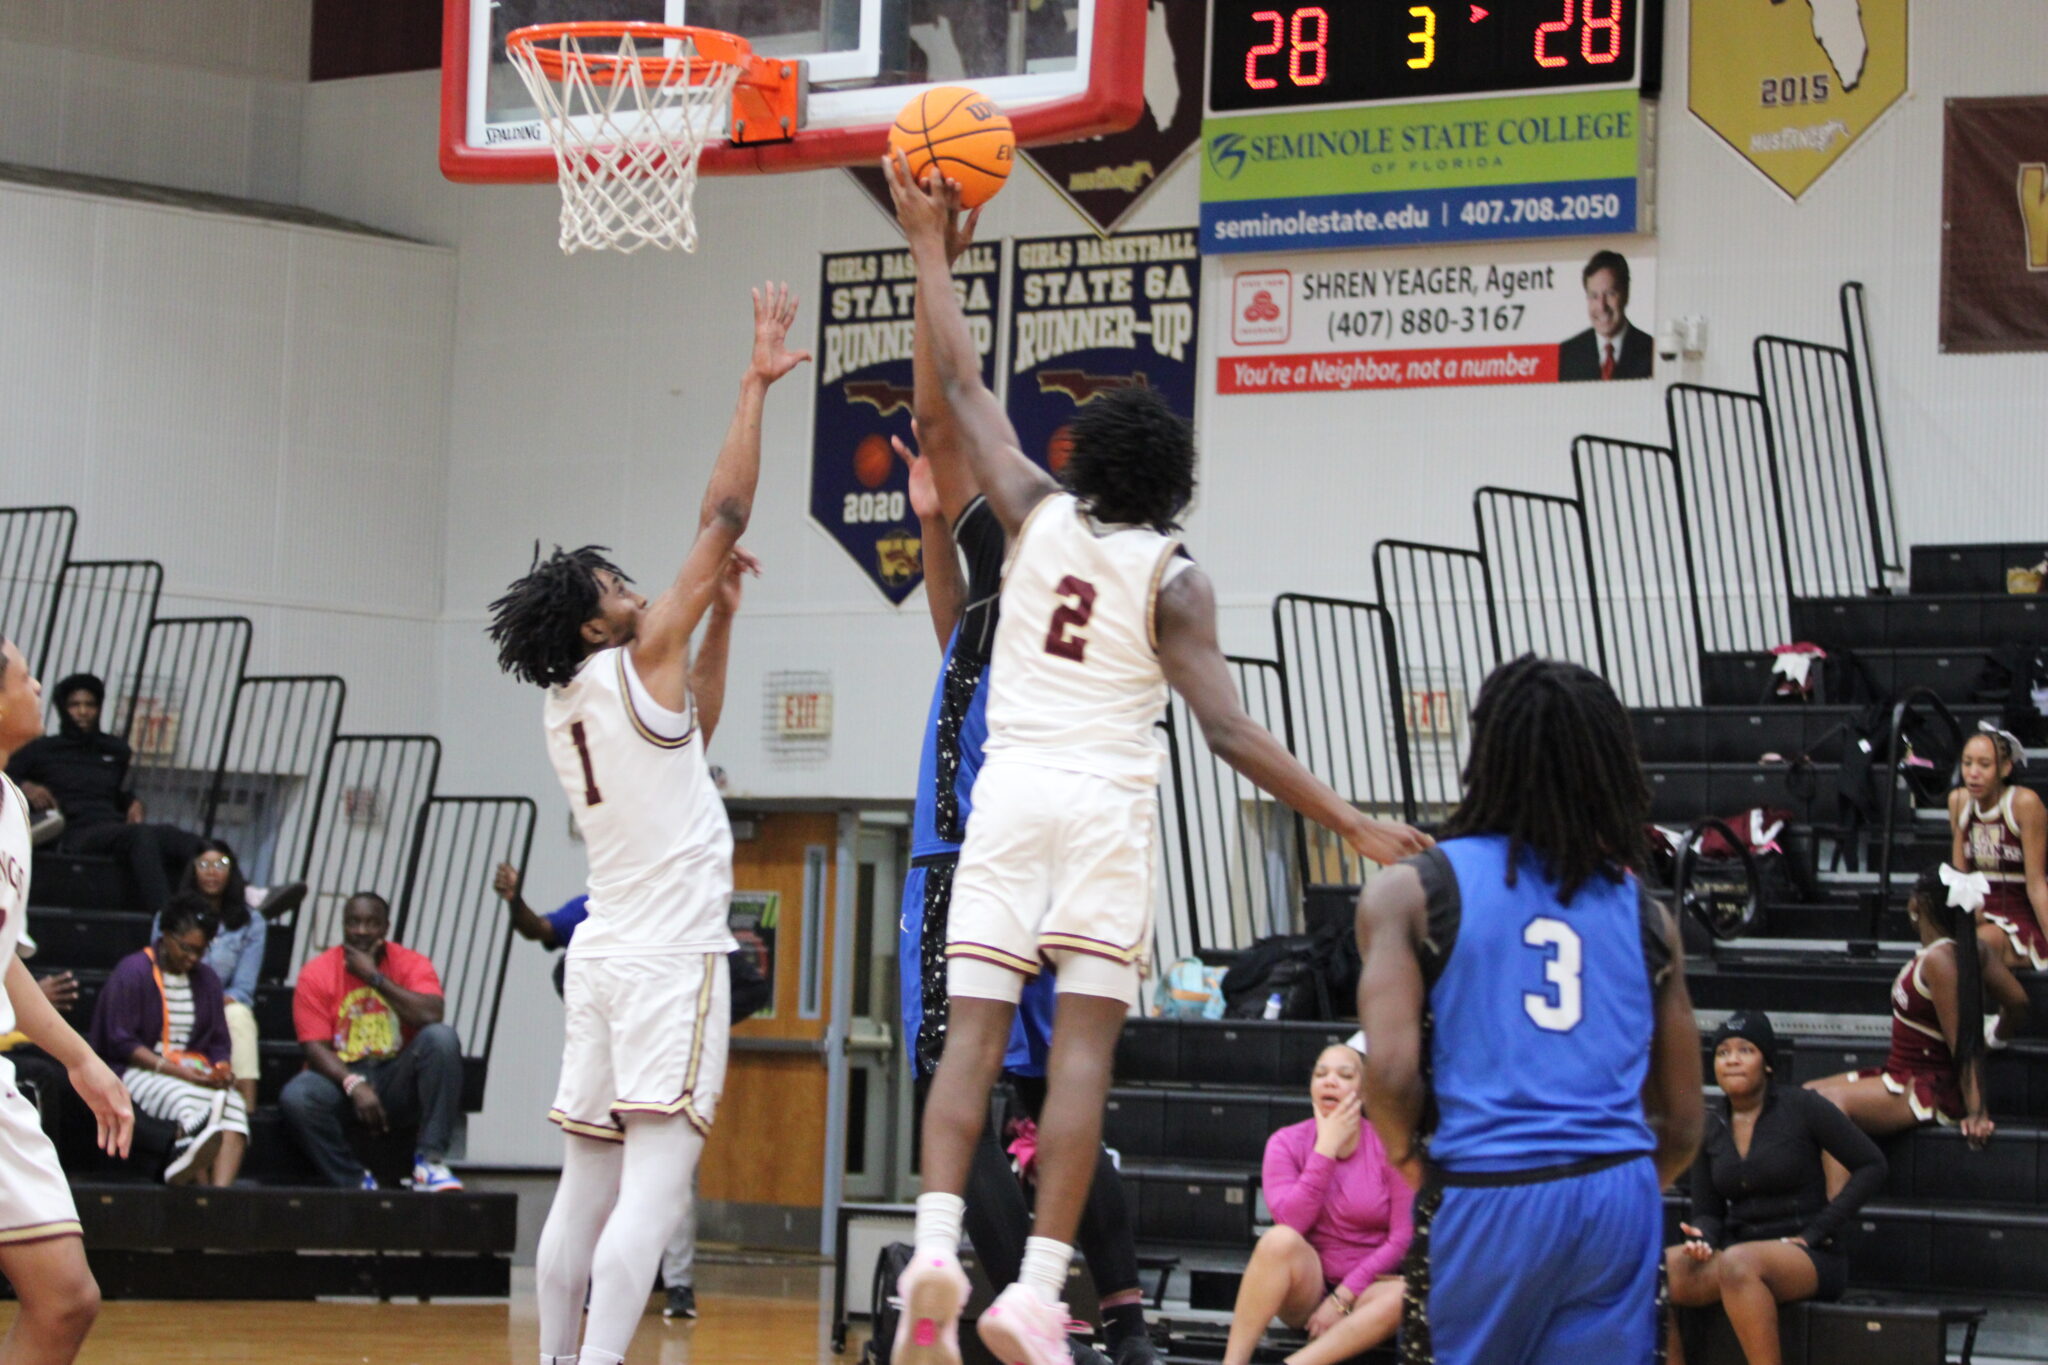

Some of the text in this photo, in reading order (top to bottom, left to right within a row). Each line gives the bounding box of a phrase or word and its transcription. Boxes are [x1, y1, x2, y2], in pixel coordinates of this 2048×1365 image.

[1245, 7, 1328, 89] 28
[1406, 6, 1435, 70] 3
[1533, 0, 1621, 68] 28
[1760, 73, 1829, 107] 2015
[1251, 111, 1632, 163] SEMINOLE STATE COLLEGE
[1372, 155, 1503, 175] OF FLORIDA
[1215, 193, 1620, 239] seminolestate.edu 407.708.2050
[826, 255, 878, 284] GIRLS
[1018, 232, 1197, 270] GIRLS BASKETBALL
[831, 283, 916, 320] STAT
[1024, 264, 1192, 307] STATE 6A
[1303, 265, 1554, 301] SHREN YEAGER, Agent
[1014, 302, 1193, 375] RUNNER-UP
[1328, 304, 1526, 342] (407) 880-3167
[1234, 351, 1540, 389] You're a Neighbor, not a number
[843, 491, 905, 524] 2020
[1044, 574, 1097, 663] 2
[571, 721, 604, 806] 1
[1522, 916, 1583, 1032] 3
